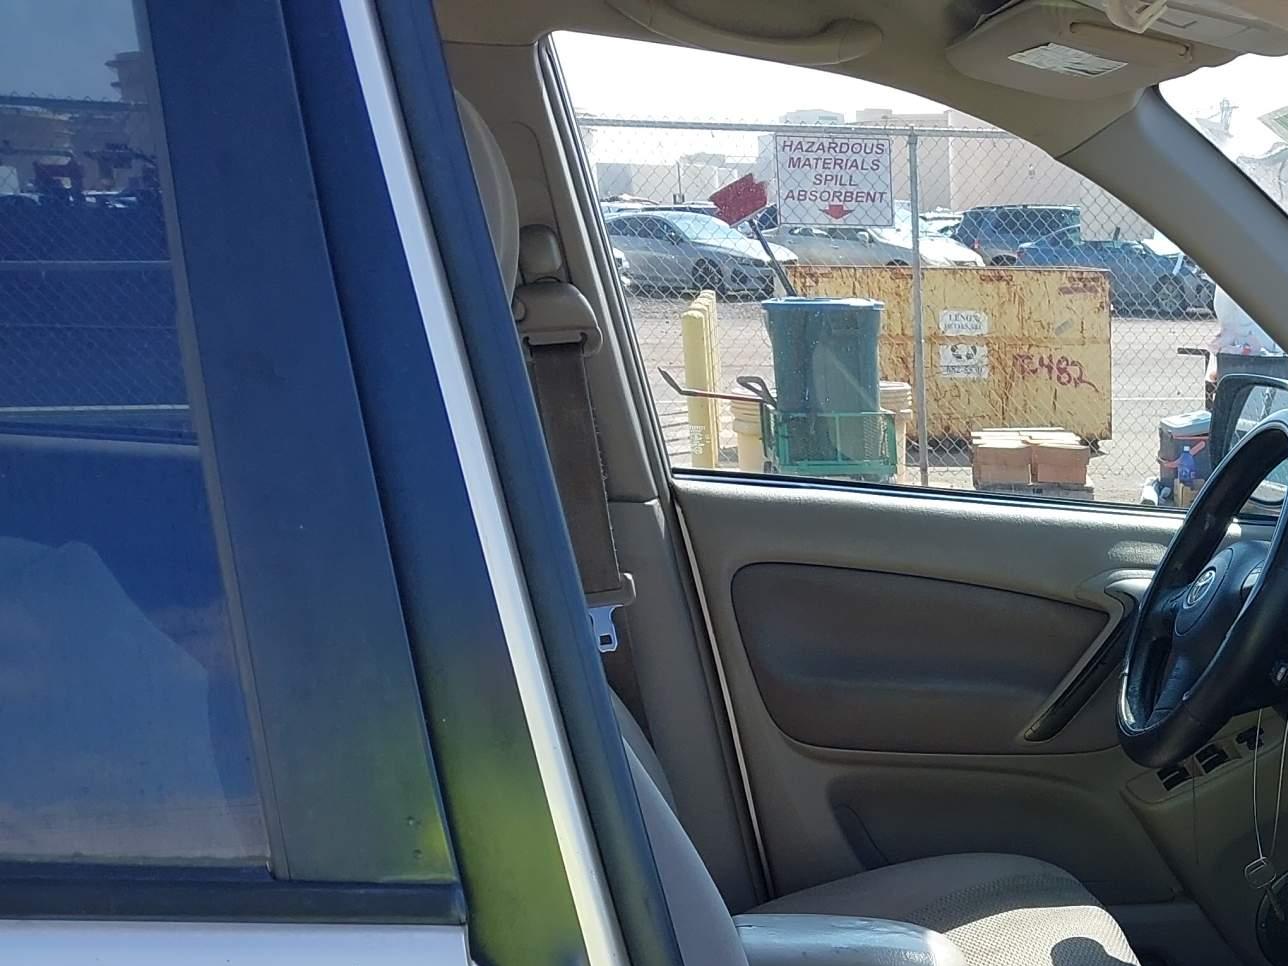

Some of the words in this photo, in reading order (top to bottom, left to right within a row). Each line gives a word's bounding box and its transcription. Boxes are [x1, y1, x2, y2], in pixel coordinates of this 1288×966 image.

[782, 140, 885, 155] HAZARDOUS
[787, 156, 881, 171] MATERIALS
[812, 173, 858, 187] SPILL
[784, 189, 888, 203] ABSORBENT
